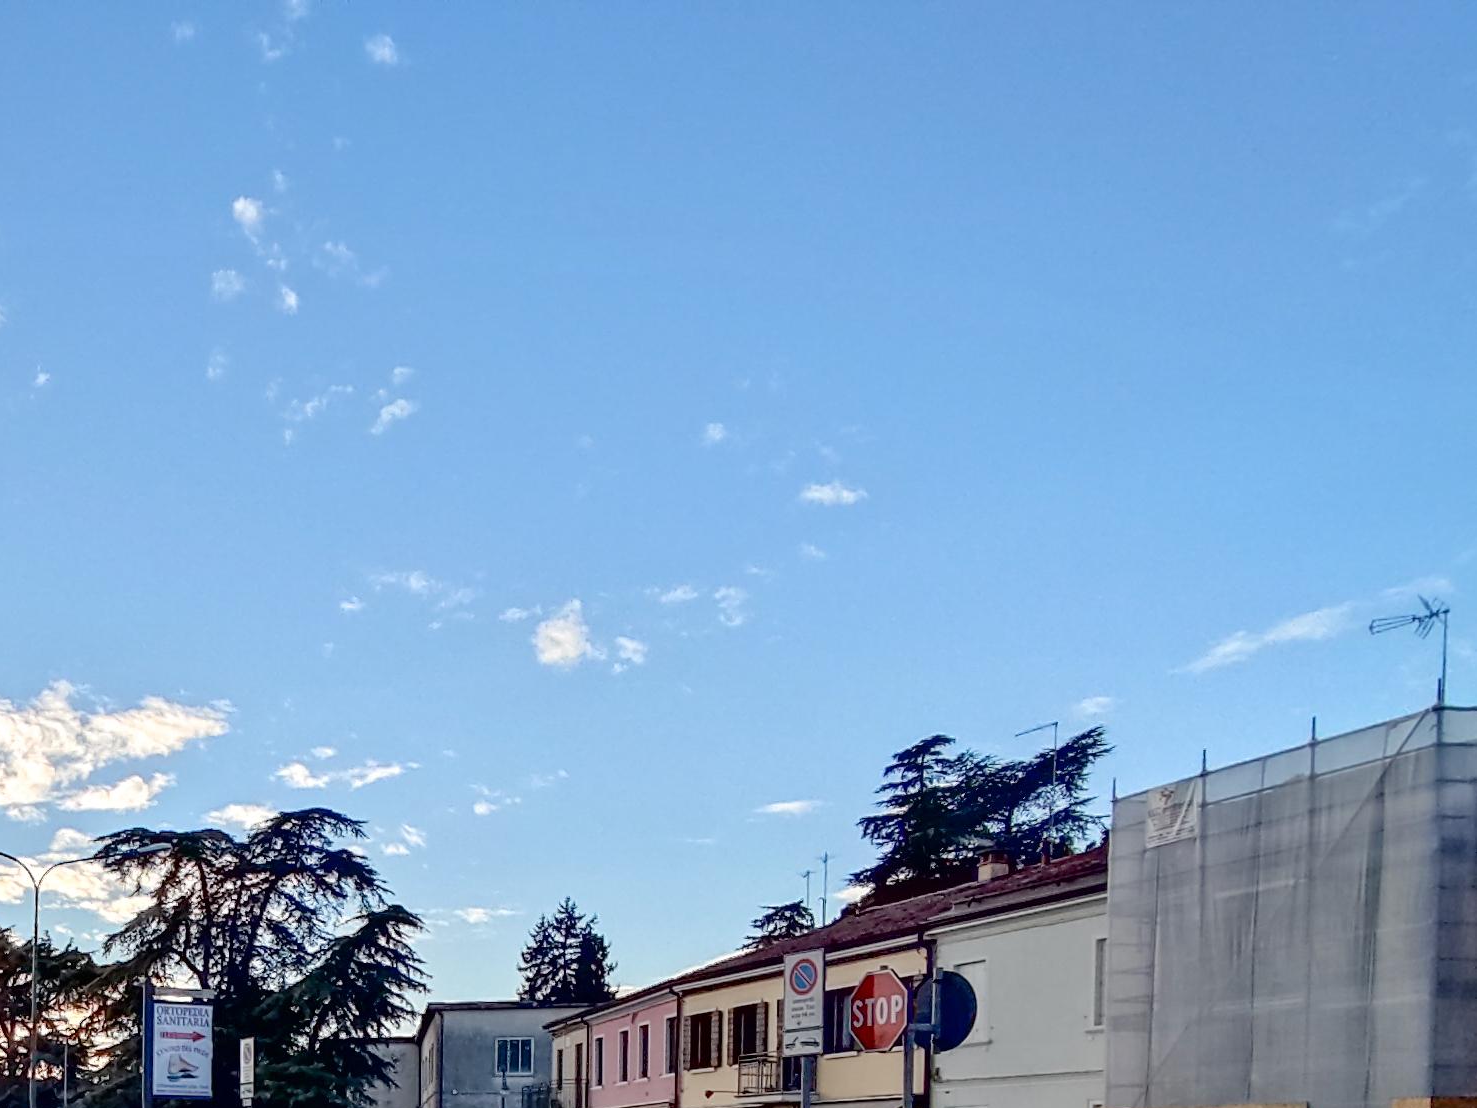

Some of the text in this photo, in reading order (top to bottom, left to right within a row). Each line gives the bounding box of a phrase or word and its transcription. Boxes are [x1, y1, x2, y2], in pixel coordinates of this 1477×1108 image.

[156, 1005, 210, 1017] ORTOPEDIA
[853, 995, 903, 1028] STOP
[156, 1016, 210, 1027] SANITARIA
